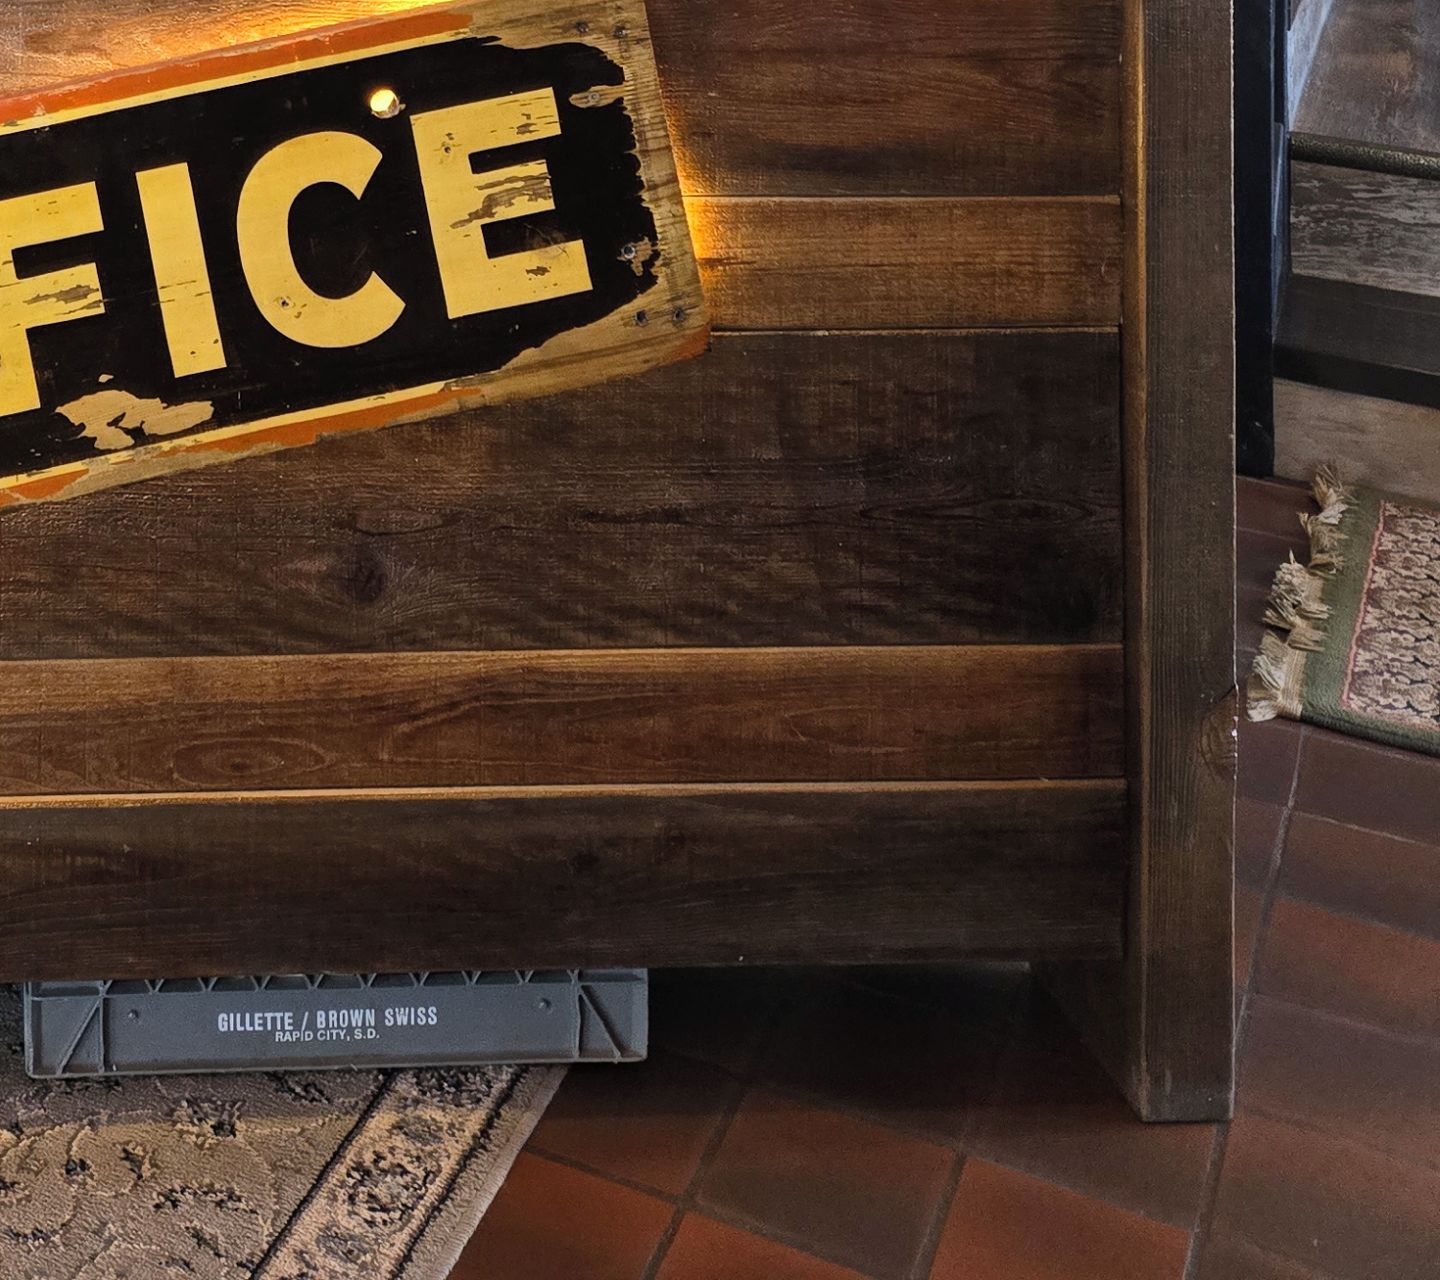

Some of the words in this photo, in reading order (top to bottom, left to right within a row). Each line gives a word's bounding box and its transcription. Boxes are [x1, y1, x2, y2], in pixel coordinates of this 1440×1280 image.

[217, 1011, 294, 1032] GILLETTE
[316, 1008, 376, 1029] BROWN
[384, 1006, 439, 1027] SWISS
[275, 1030, 314, 1042] RAPID
[317, 1029, 350, 1041] CITY,
[354, 1028, 380, 1040] S.D.
